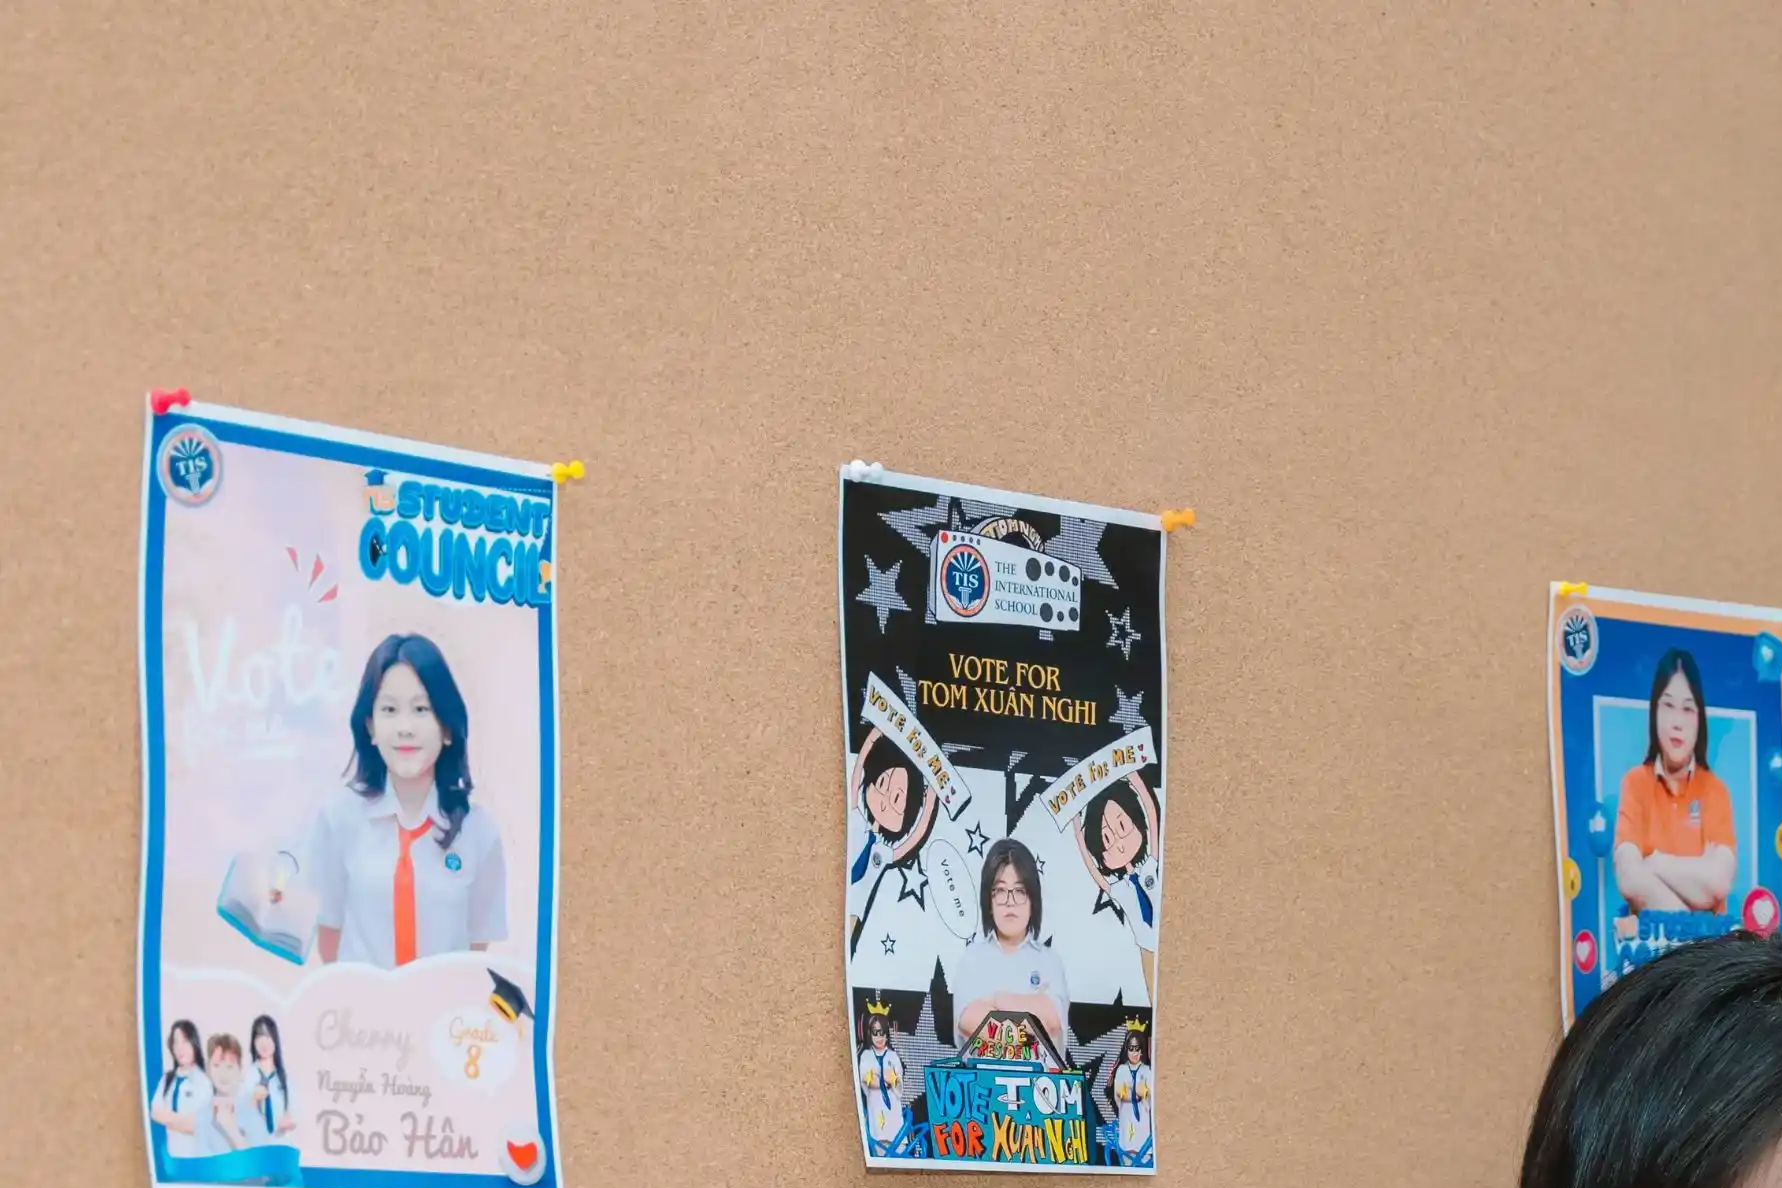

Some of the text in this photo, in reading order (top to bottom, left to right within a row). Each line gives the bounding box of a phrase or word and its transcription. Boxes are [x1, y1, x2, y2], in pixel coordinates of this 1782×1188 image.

[175, 456, 208, 476] TIS
[397, 480, 551, 539] STUDENT
[359, 516, 551, 609] COUNCIL
[952, 571, 979, 589] TIS
[995, 561, 1017, 575] THE
[994, 599, 1038, 616] SCHOOL
[995, 580, 1078, 603] INTERNATIONAL
[185, 602, 345, 713] Vote
[949, 653, 1061, 692] VOTE FOR
[868, 685, 906, 732] VOTE
[918, 680, 1097, 726] TOM XUÂN NGHI
[1048, 773, 1086, 814] VOTE
[1112, 745, 1136, 767] ME
[941, 859, 964, 917] Vote me
[315, 1006, 410, 1072] Cherry
[449, 1016, 499, 1046] Grade
[464, 1045, 481, 1080] 8
[928, 1072, 1083, 1124] VOTE TOM
[316, 1109, 479, 1159] Bảo Hân
[933, 1120, 984, 1158] FOR
[1044, 1119, 1088, 1164] NGHI
